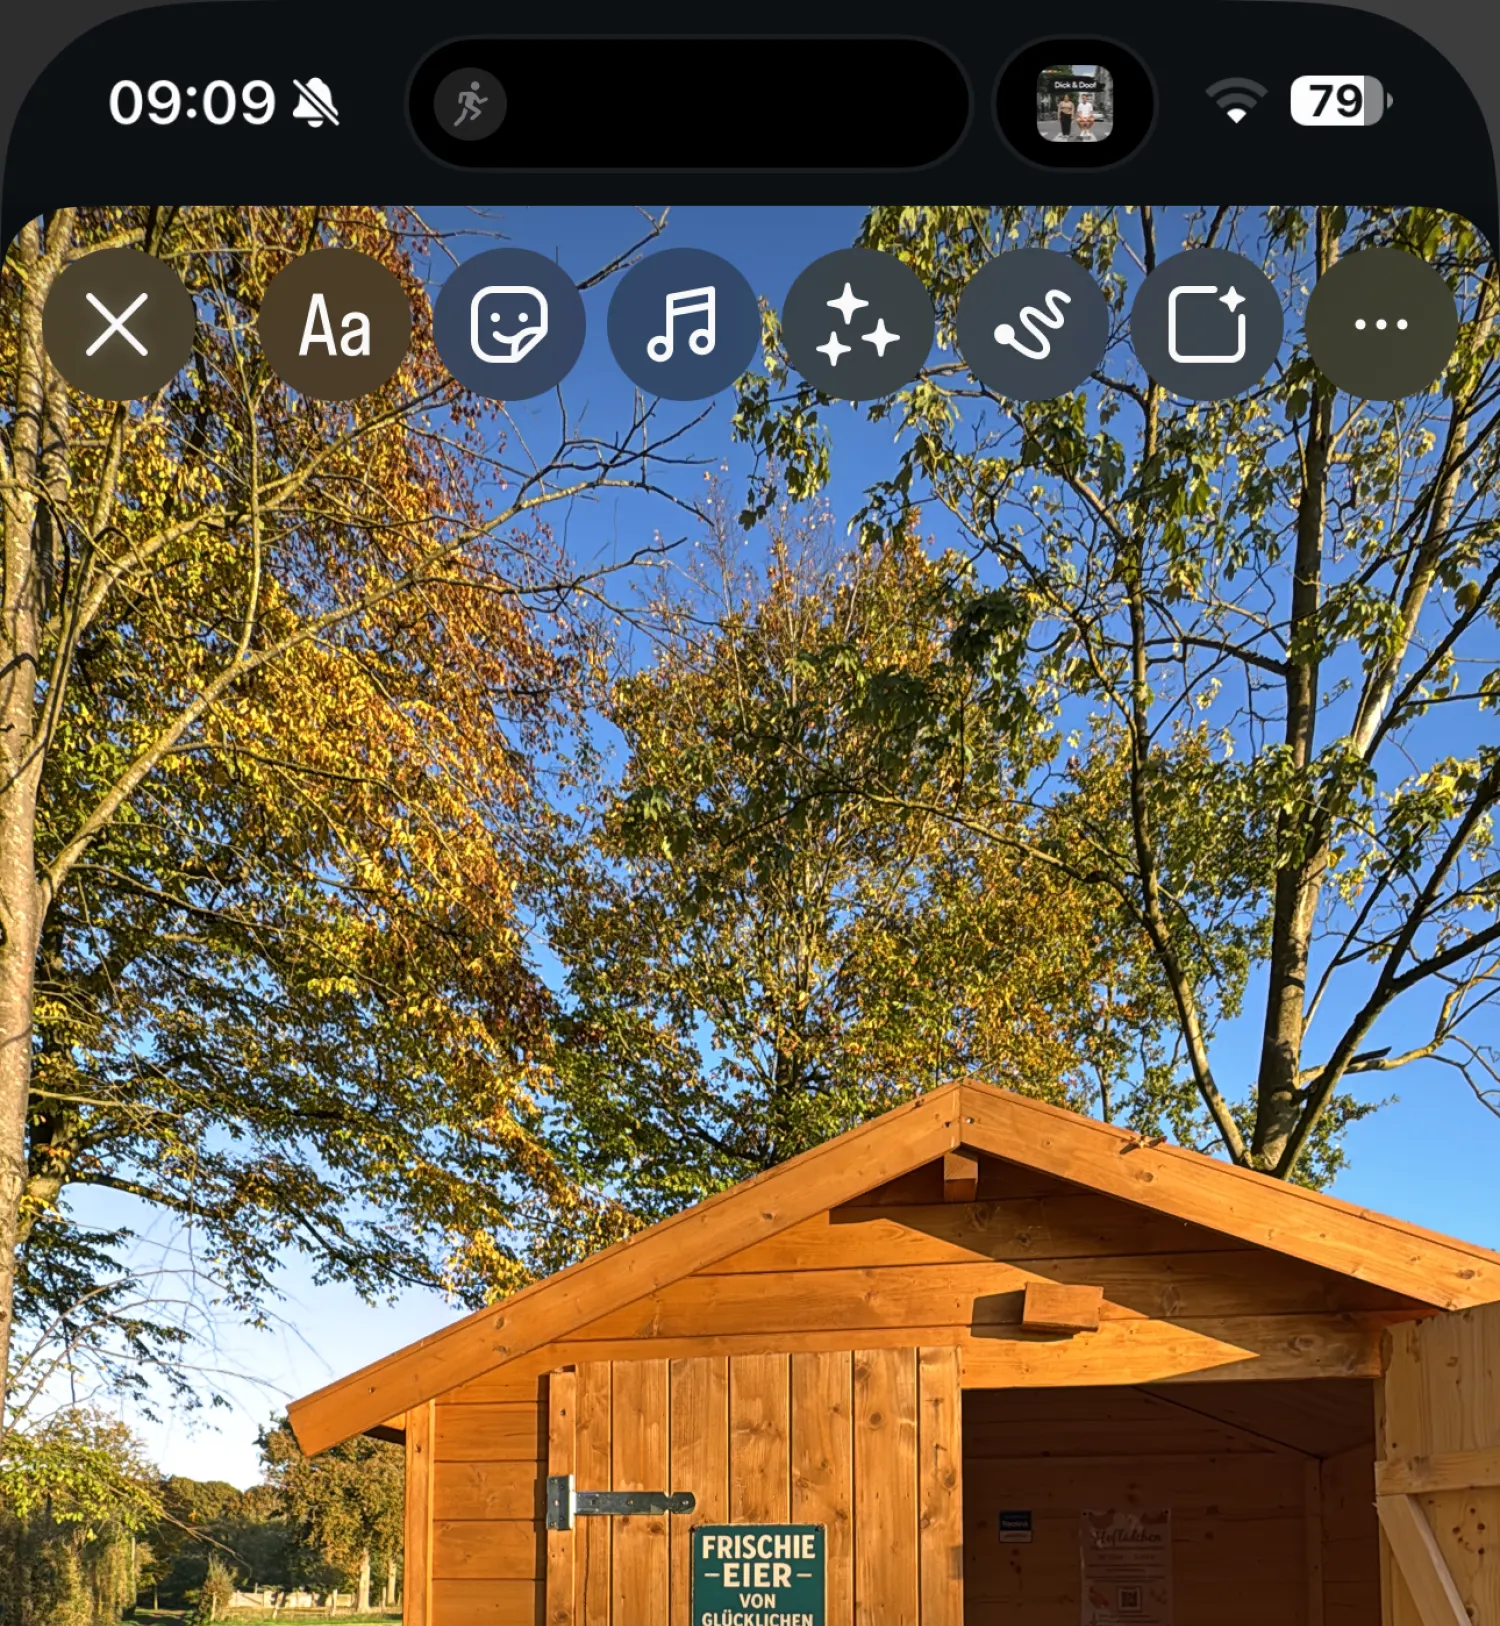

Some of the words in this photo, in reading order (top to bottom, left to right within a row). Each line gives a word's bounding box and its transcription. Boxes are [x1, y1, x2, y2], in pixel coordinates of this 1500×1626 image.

[702, 1535, 816, 1559] FRISCHIE
[723, 1562, 792, 1588] EIER
[739, 1593, 776, 1609] VON
